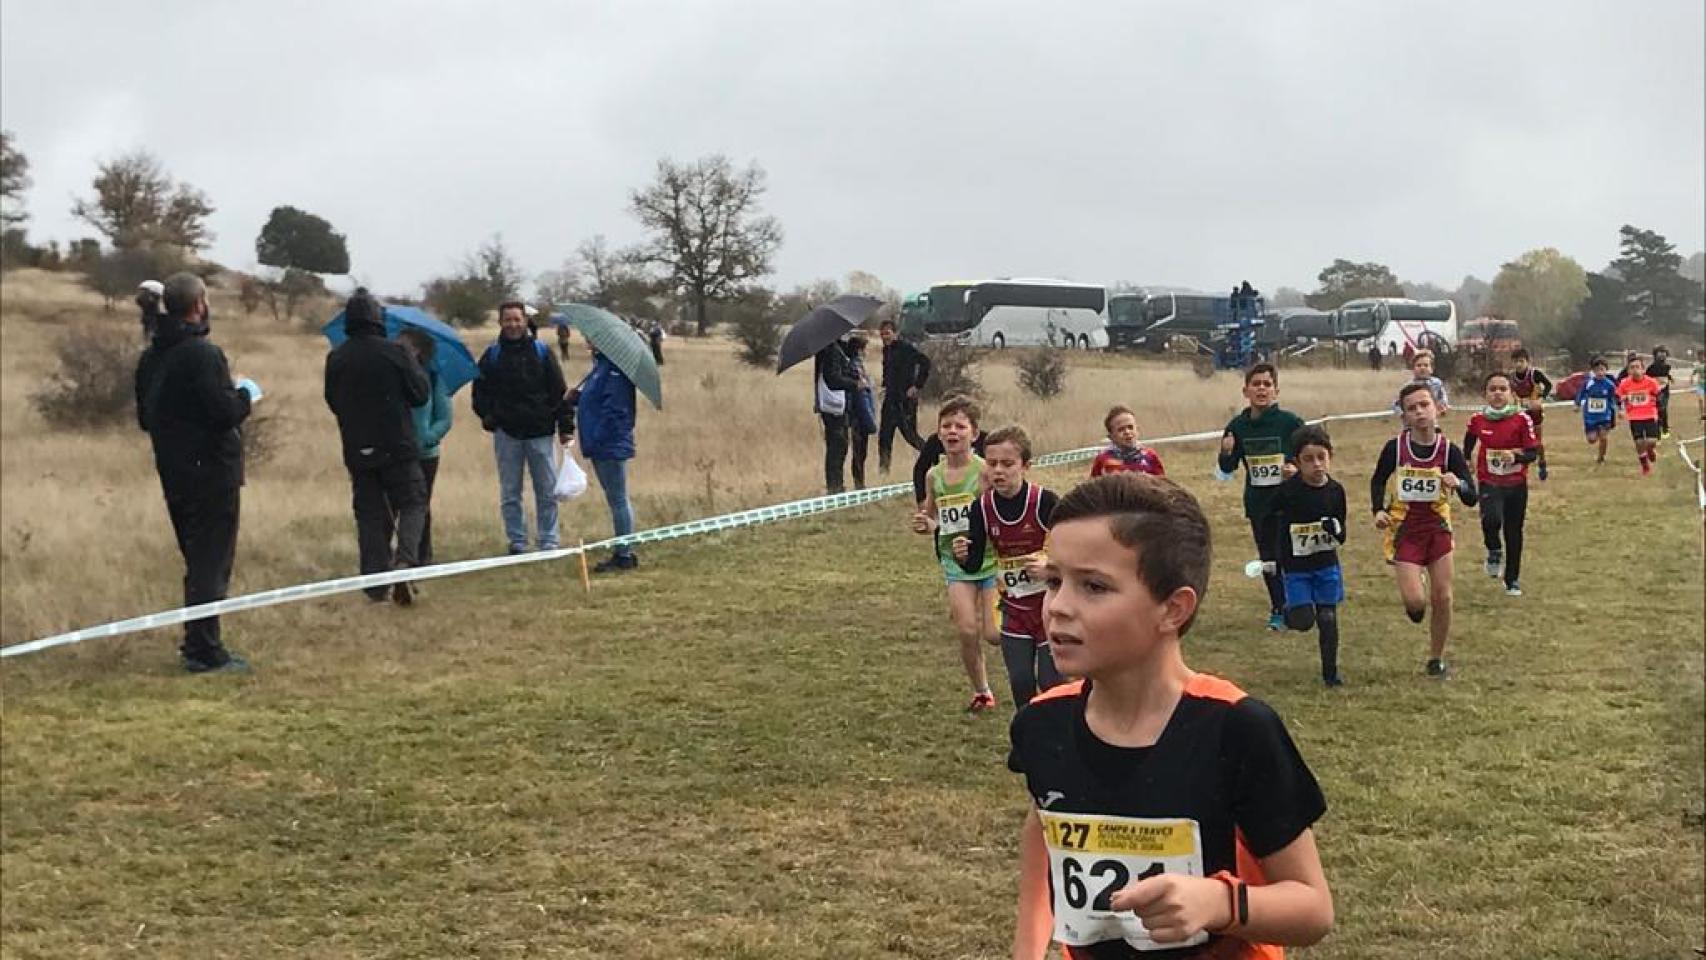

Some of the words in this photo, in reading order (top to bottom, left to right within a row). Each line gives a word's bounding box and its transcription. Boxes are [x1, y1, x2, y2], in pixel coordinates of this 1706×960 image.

[1251, 465, 1280, 477] 692
[1402, 479, 1436, 493] 645
[941, 505, 970, 524] 604
[1004, 570, 1031, 588] 64
[1059, 822, 1091, 848] 27
